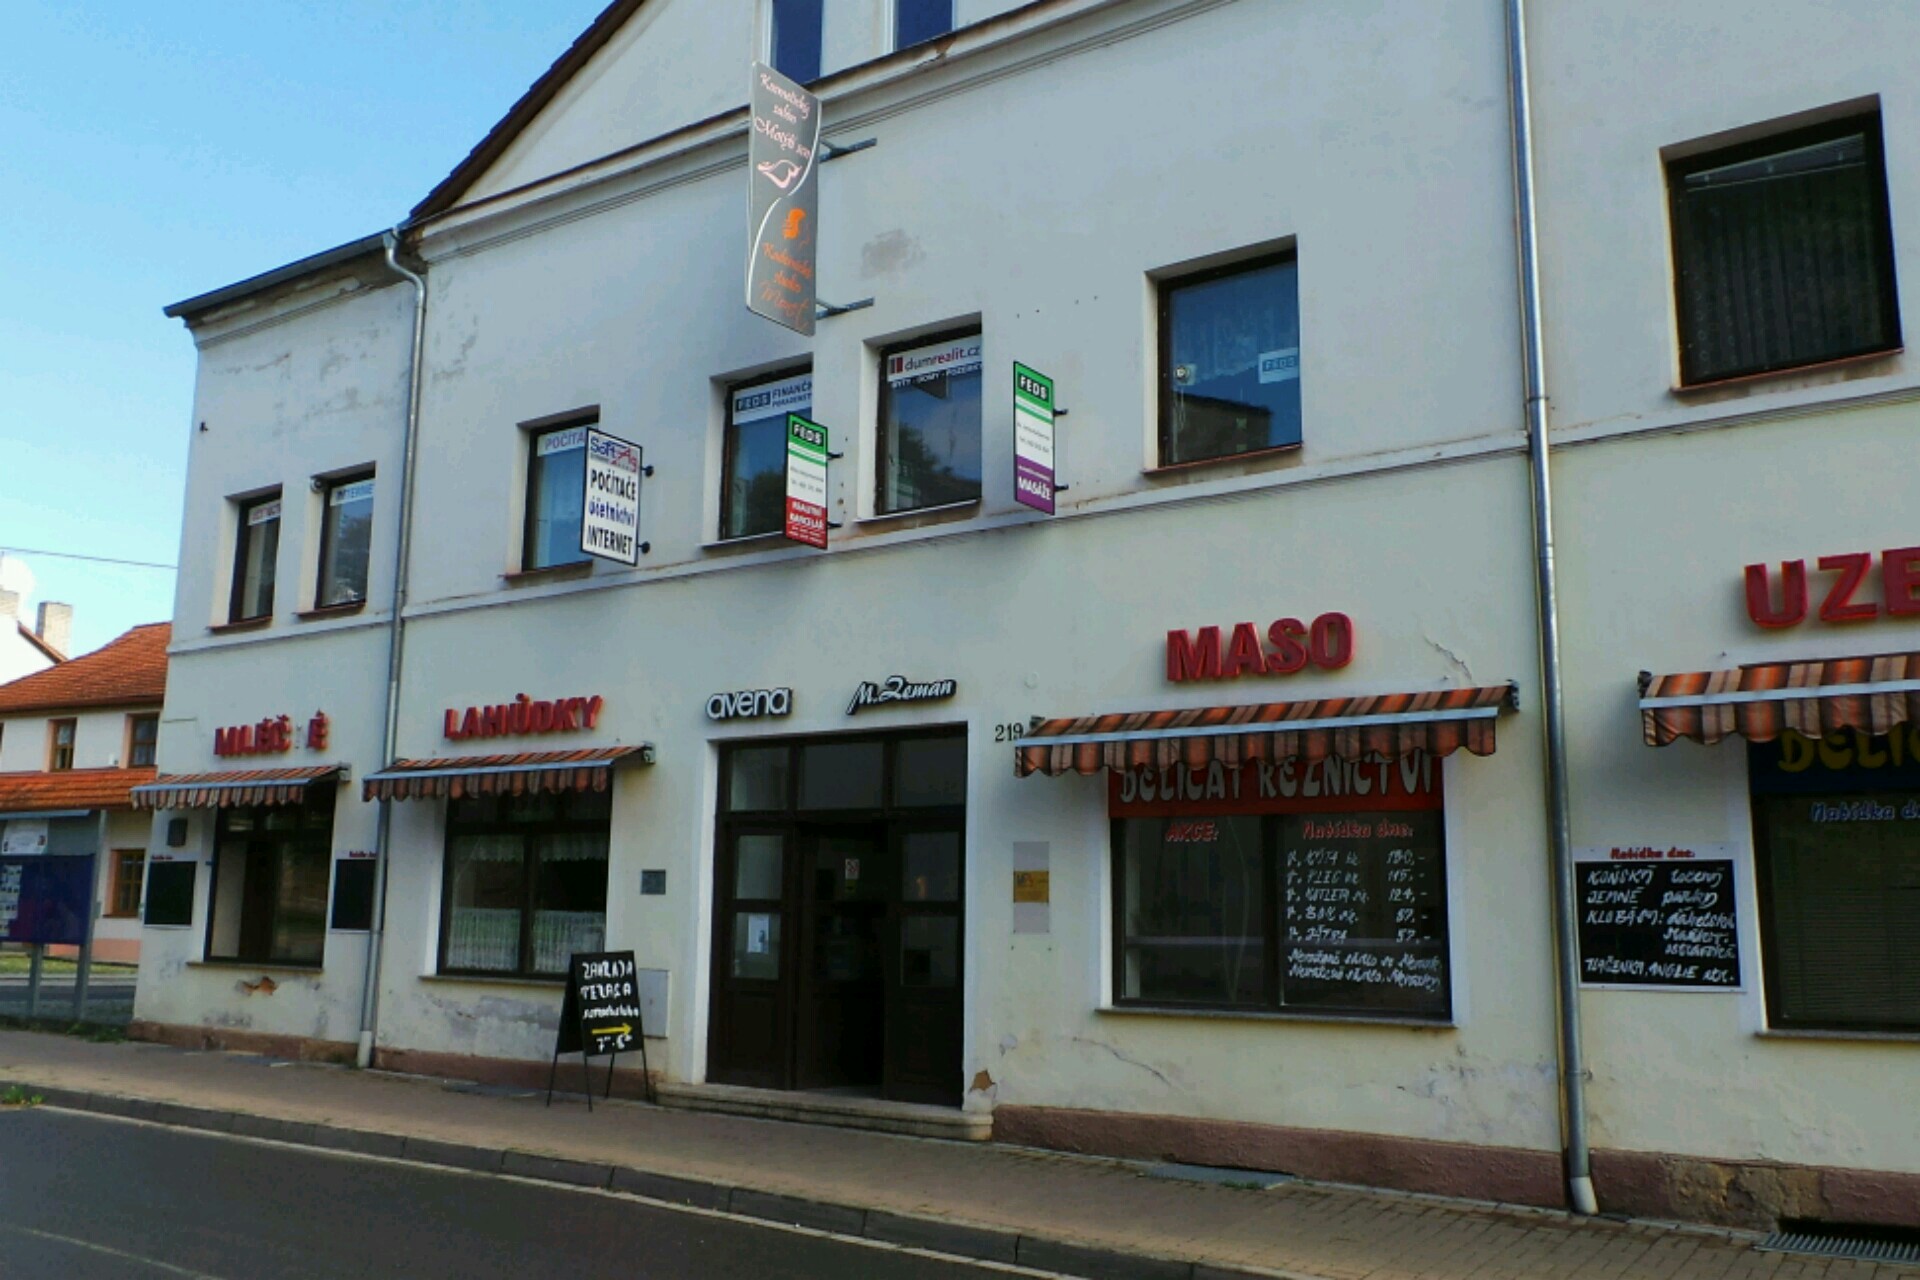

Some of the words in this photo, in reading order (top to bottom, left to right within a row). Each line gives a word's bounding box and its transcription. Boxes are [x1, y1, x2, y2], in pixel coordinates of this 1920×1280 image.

[904, 346, 981, 371] dumrealit.cz
[1019, 375, 1047, 401] FEDS
[793, 423, 823, 447] FEDS
[590, 468, 637, 502] POČÍTAČE
[586, 525, 634, 556] INTERNET
[1166, 612, 1357, 683] MASO
[444, 693, 604, 741] LAHŮDKY
[706, 688, 794, 720] avena
[995, 723, 1024, 743] 219
